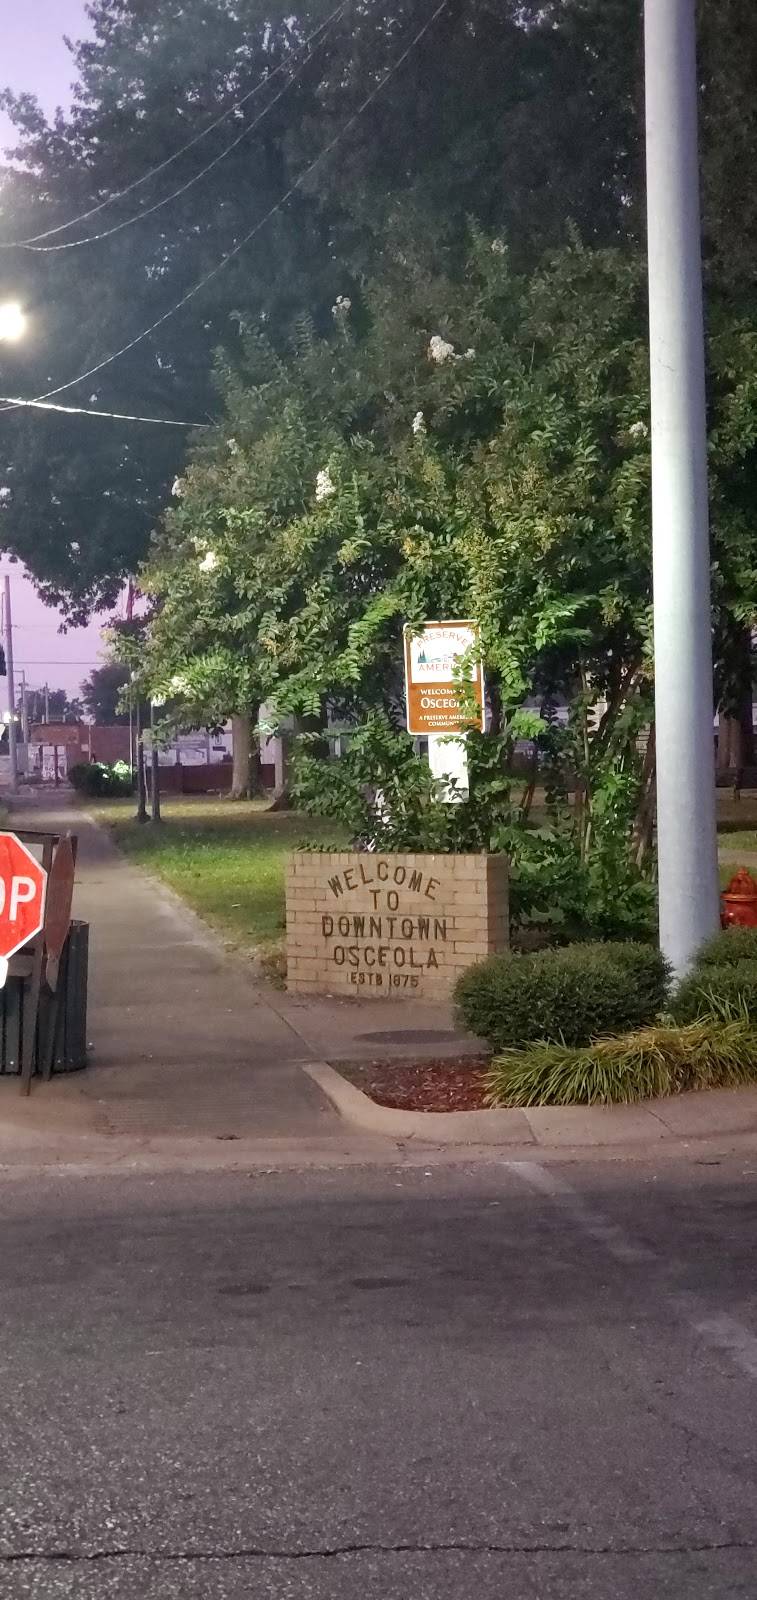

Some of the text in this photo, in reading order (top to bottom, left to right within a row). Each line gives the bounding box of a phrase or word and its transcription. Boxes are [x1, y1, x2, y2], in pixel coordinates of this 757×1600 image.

[416, 631, 468, 649] PRESERVE
[327, 860, 441, 901] WELCOME
[0, 876, 37, 921] P
[369, 888, 400, 911] TO
[321, 915, 447, 941] DOWNTOWN
[333, 945, 439, 969] OSCEOLA
[388, 973, 420, 988] 1875
